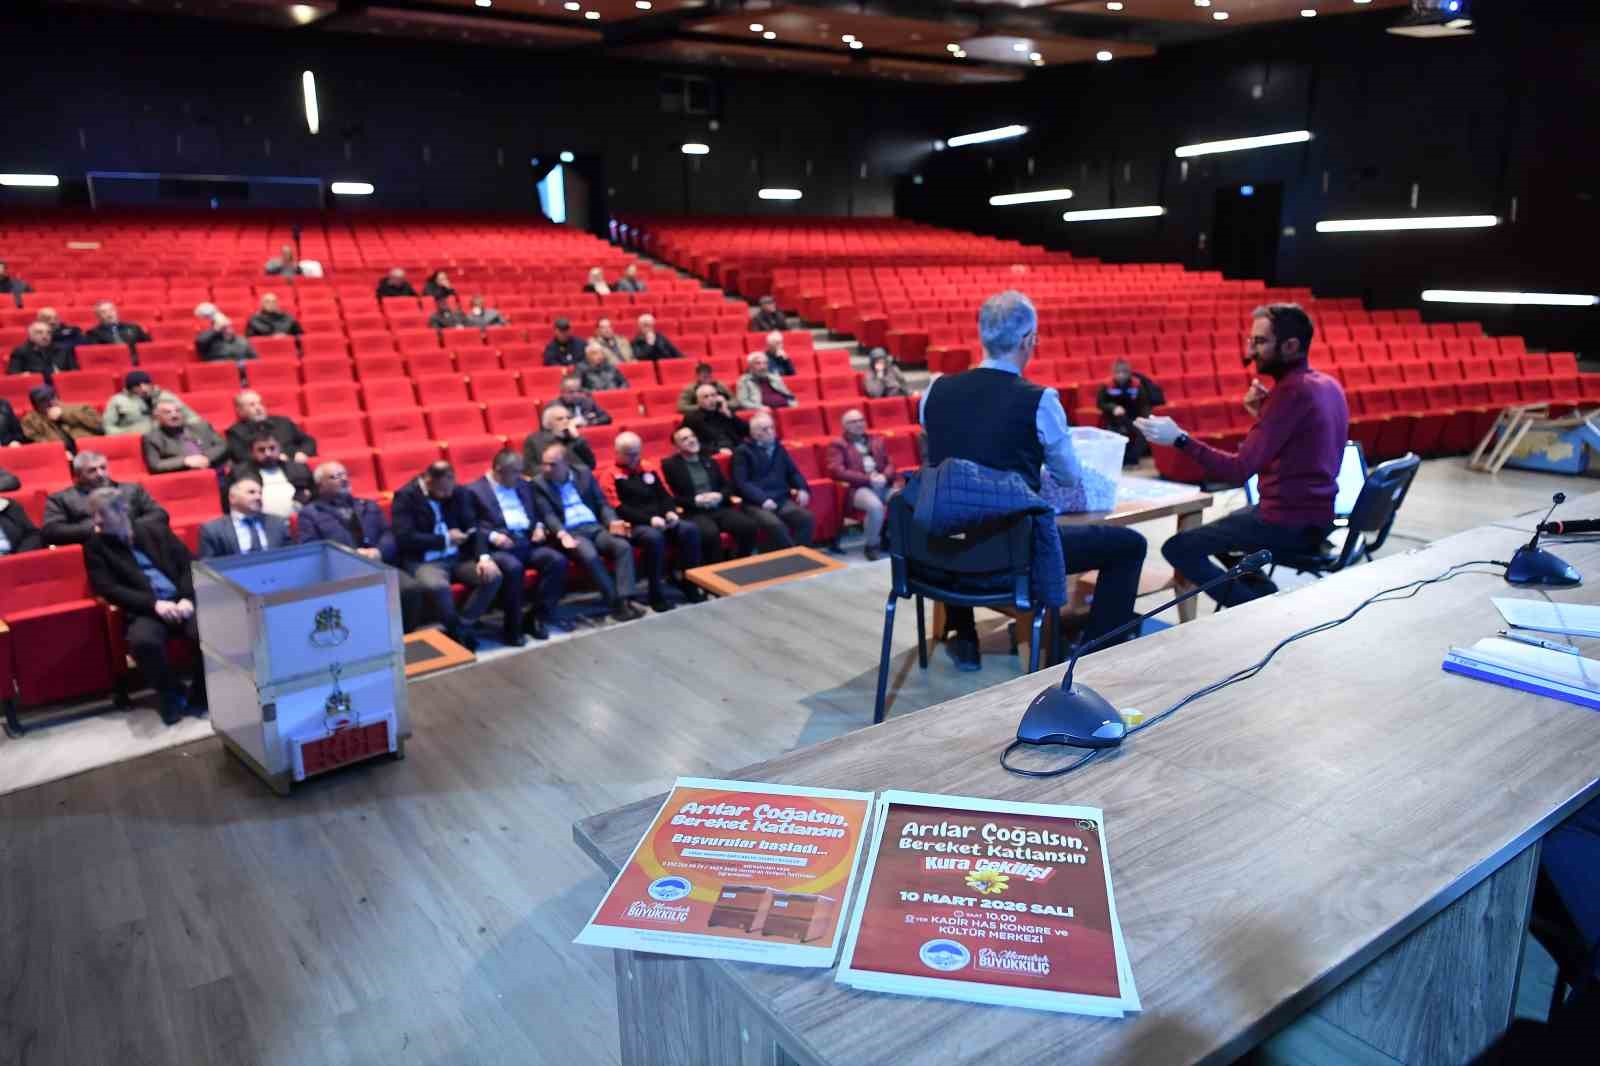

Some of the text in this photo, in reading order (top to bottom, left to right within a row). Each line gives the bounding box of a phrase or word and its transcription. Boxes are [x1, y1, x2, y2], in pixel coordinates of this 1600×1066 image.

[680, 802, 750, 817] Arılar
[671, 814, 845, 838] Bereket Katlansın
[902, 822, 976, 838] Arılar
[671, 834, 757, 849] Başvurular
[899, 837, 1087, 864] Bereket Katlansın
[925, 856, 971, 870] Kura
[899, 891, 1074, 918] 10 MART 2026 SALI
[931, 915, 969, 926] KADİR
[972, 920, 997, 929] HAS
[999, 924, 1052, 936] KONGRE
[986, 912, 1017, 922] 10.00
[939, 926, 1043, 944] KÜLTÜR MERKEZİ
